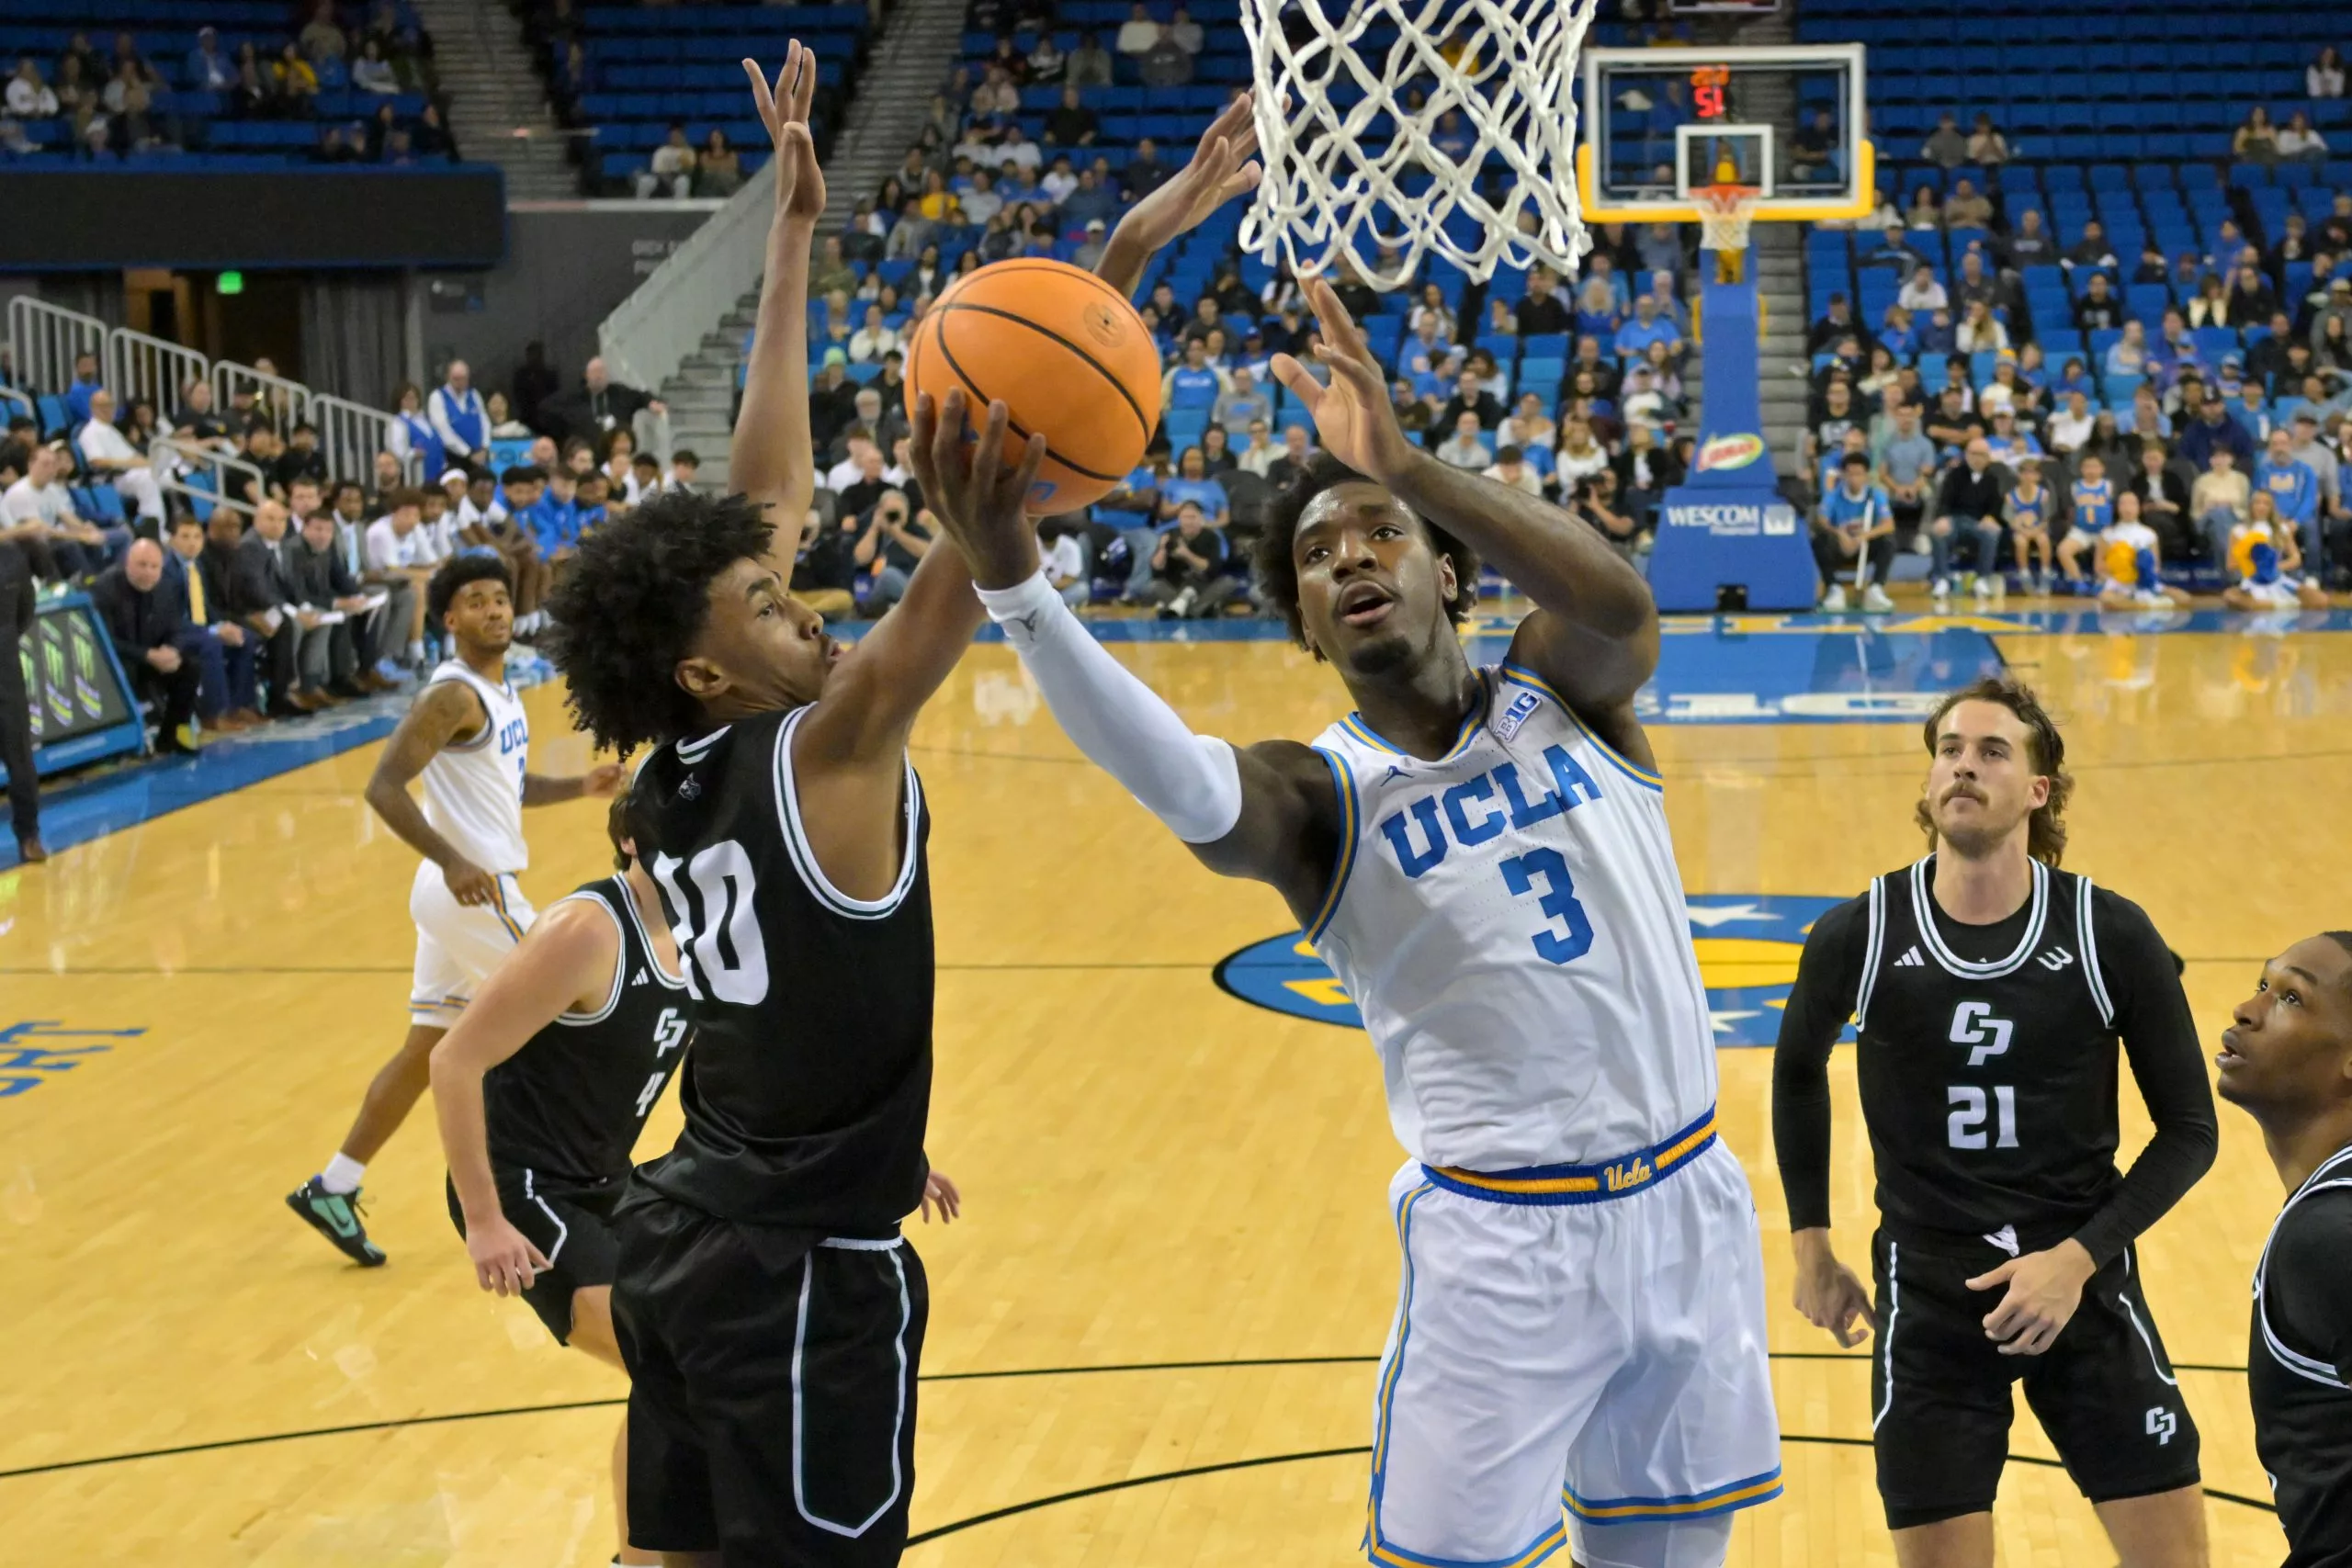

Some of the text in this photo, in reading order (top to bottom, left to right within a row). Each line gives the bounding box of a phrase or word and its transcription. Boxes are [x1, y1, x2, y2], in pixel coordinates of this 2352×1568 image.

[1667, 505, 1758, 526] WESCOM
[500, 718, 528, 755] UCL
[1380, 744, 1602, 878] UCLA
[652, 839, 769, 1006] 10
[1498, 847, 1594, 964] 3
[1949, 1001, 2014, 1066] CP
[1947, 1086, 2020, 1148] 21
[1603, 1156, 1653, 1192] Ucla
[2146, 1406, 2176, 1446] CP
